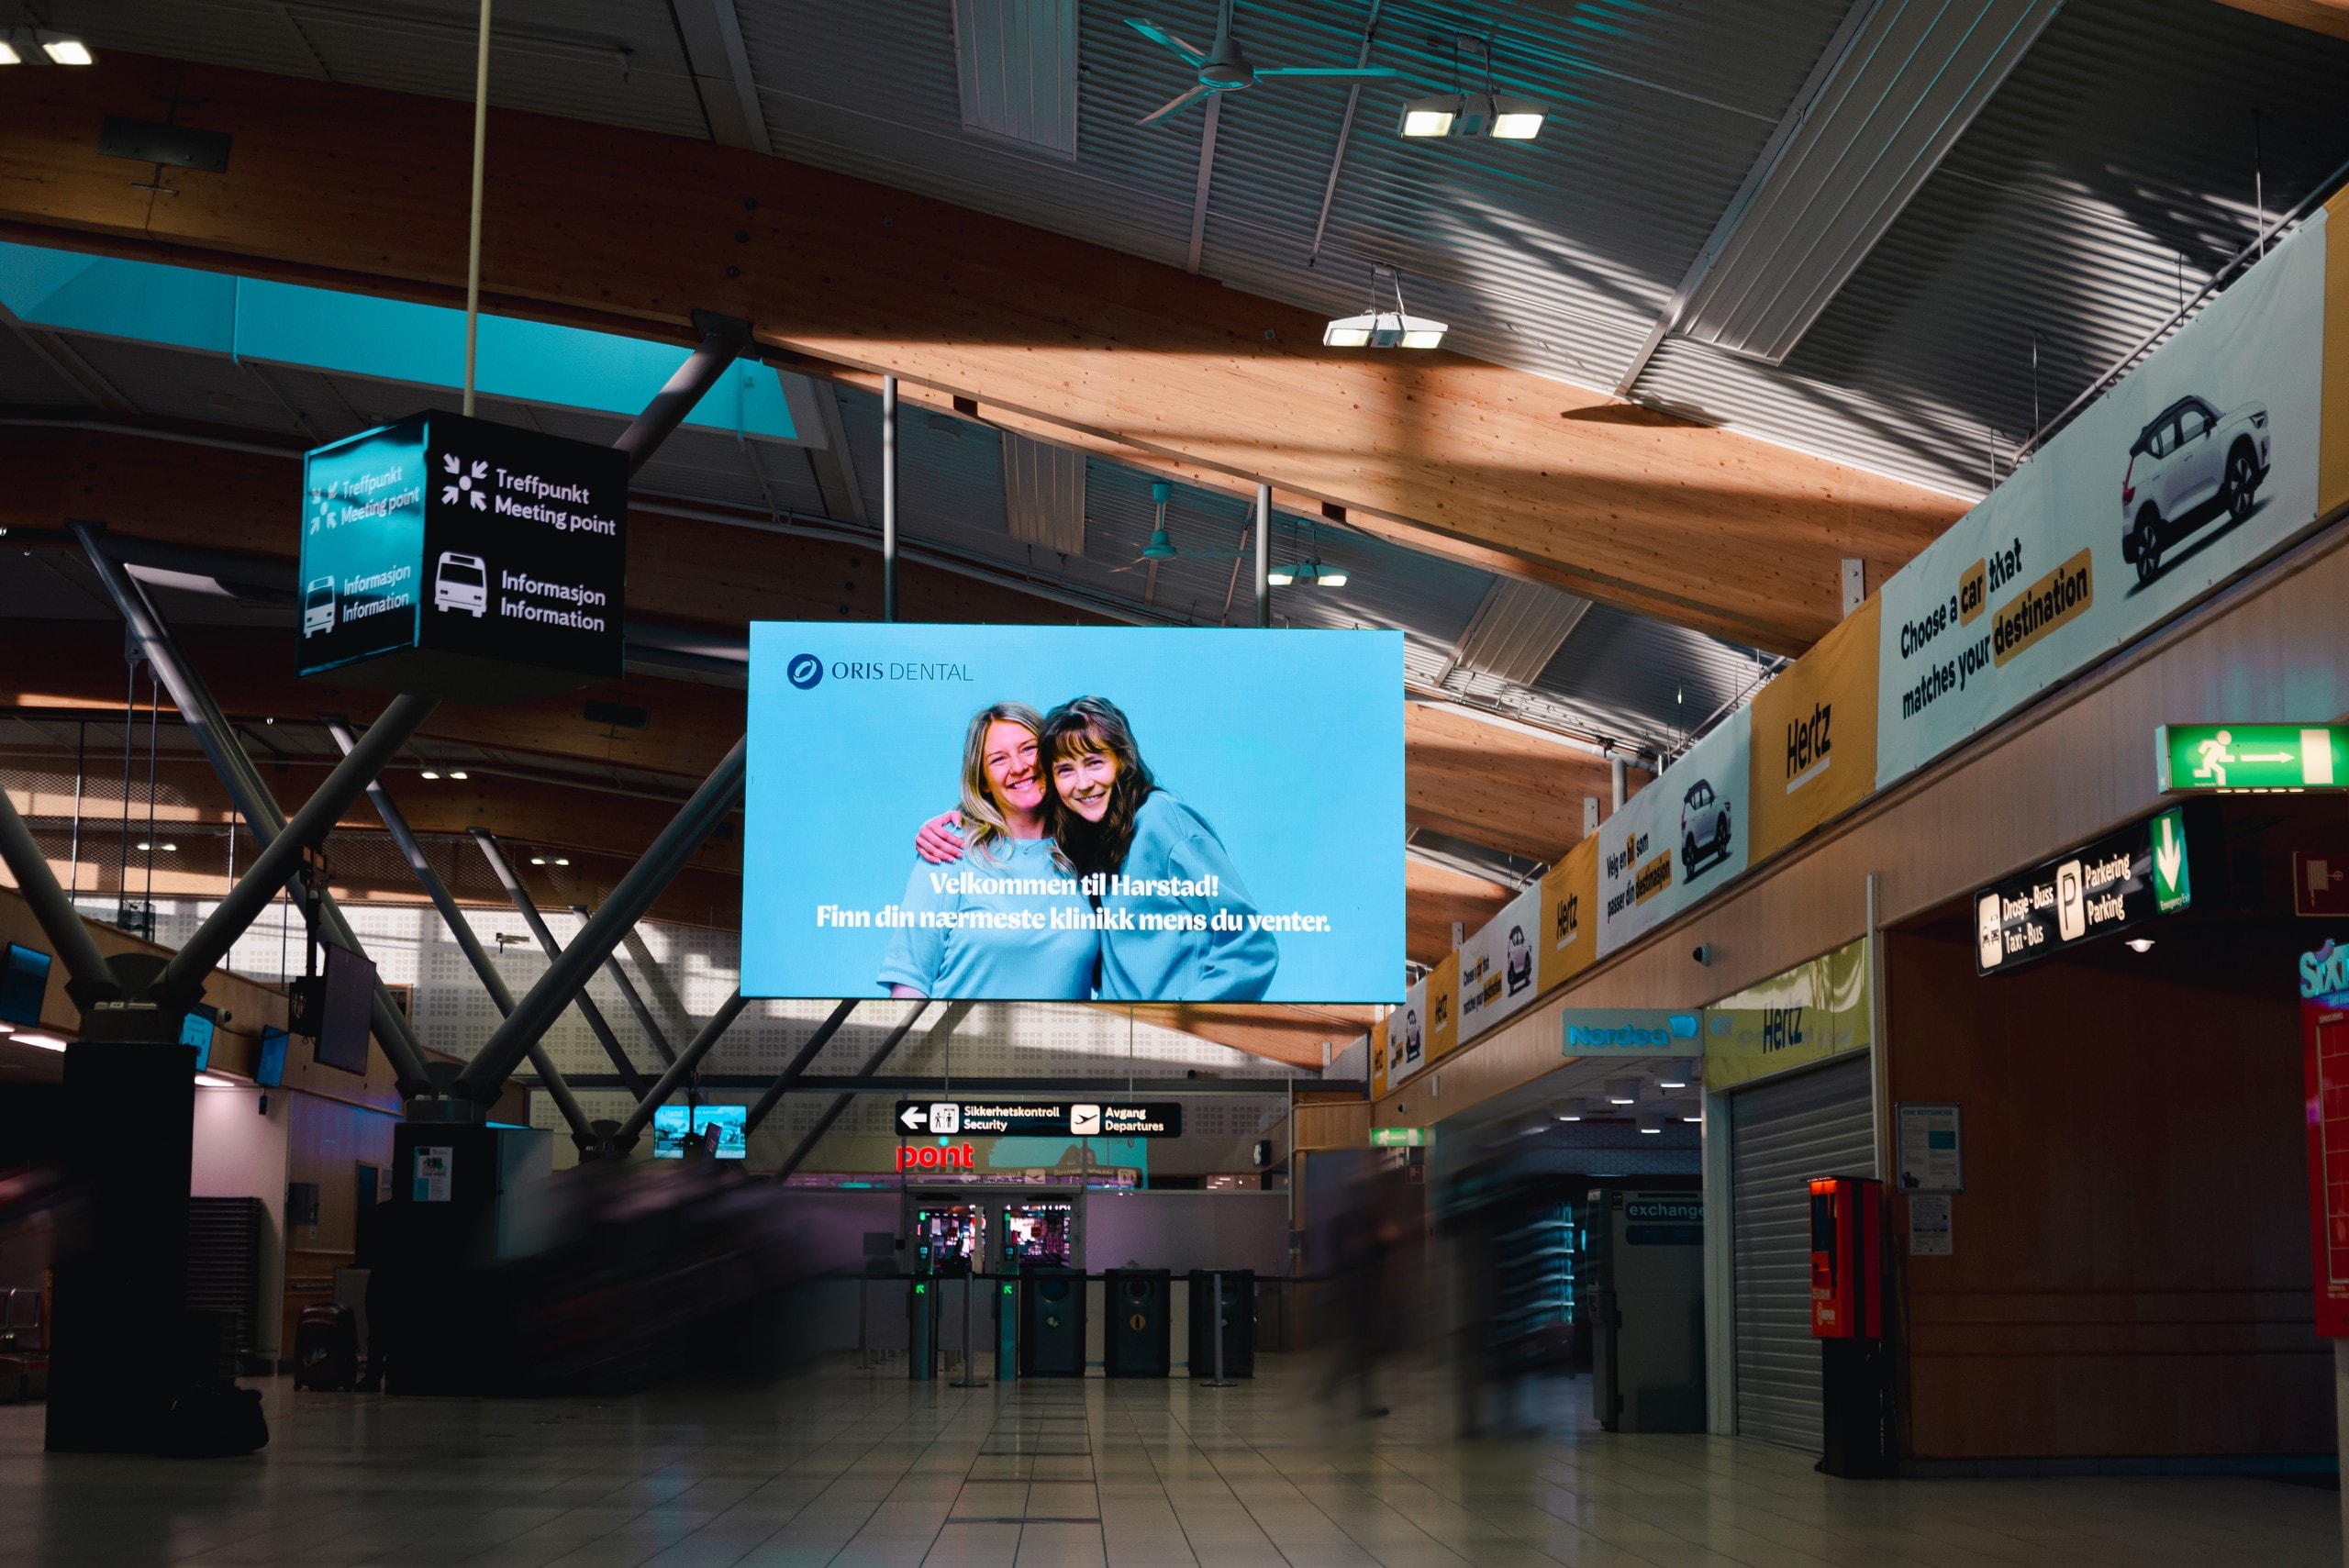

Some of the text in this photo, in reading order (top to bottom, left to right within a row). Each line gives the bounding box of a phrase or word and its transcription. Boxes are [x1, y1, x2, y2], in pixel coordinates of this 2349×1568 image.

[342, 466, 402, 499] Treffpunkt
[496, 469, 589, 505] Treffpunkt
[341, 486, 420, 526] Meeting point
[495, 495, 616, 536] Meeting point
[344, 565, 411, 597] Informasjon
[502, 571, 606, 606] Informasjon
[343, 592, 409, 623] Information
[501, 597, 605, 631] Information
[1901, 538, 2022, 659] Choose a car that
[1903, 567, 2087, 719] matches your destination
[832, 662, 974, 681] ORIS DENTAL
[1787, 703, 1831, 778] Hertz
[1607, 853, 1619, 880] Velg
[1620, 851, 1626, 871] en
[1637, 832, 1648, 858] som
[2085, 853, 2131, 890] Parkering
[930, 872, 1219, 897] Velkommen til Harstad!
[817, 906, 1330, 934] Finn din nærmeste klinikk mens du venter.
[1556, 894, 1578, 940] Hertz
[1608, 892, 1624, 924] passer
[2087, 895, 2125, 925] Parking
[1435, 992, 1448, 1025] Hertz
[1763, 995, 1803, 1055] Hertz
[1568, 1023, 1670, 1046] Nordea
[963, 1106, 1060, 1118] Sikkerhetskontroll
[963, 1119, 1008, 1132] Security
[1105, 1106, 1146, 1120] Avgang
[1105, 1121, 1163, 1132] Departures
[896, 1136, 974, 1173] point
